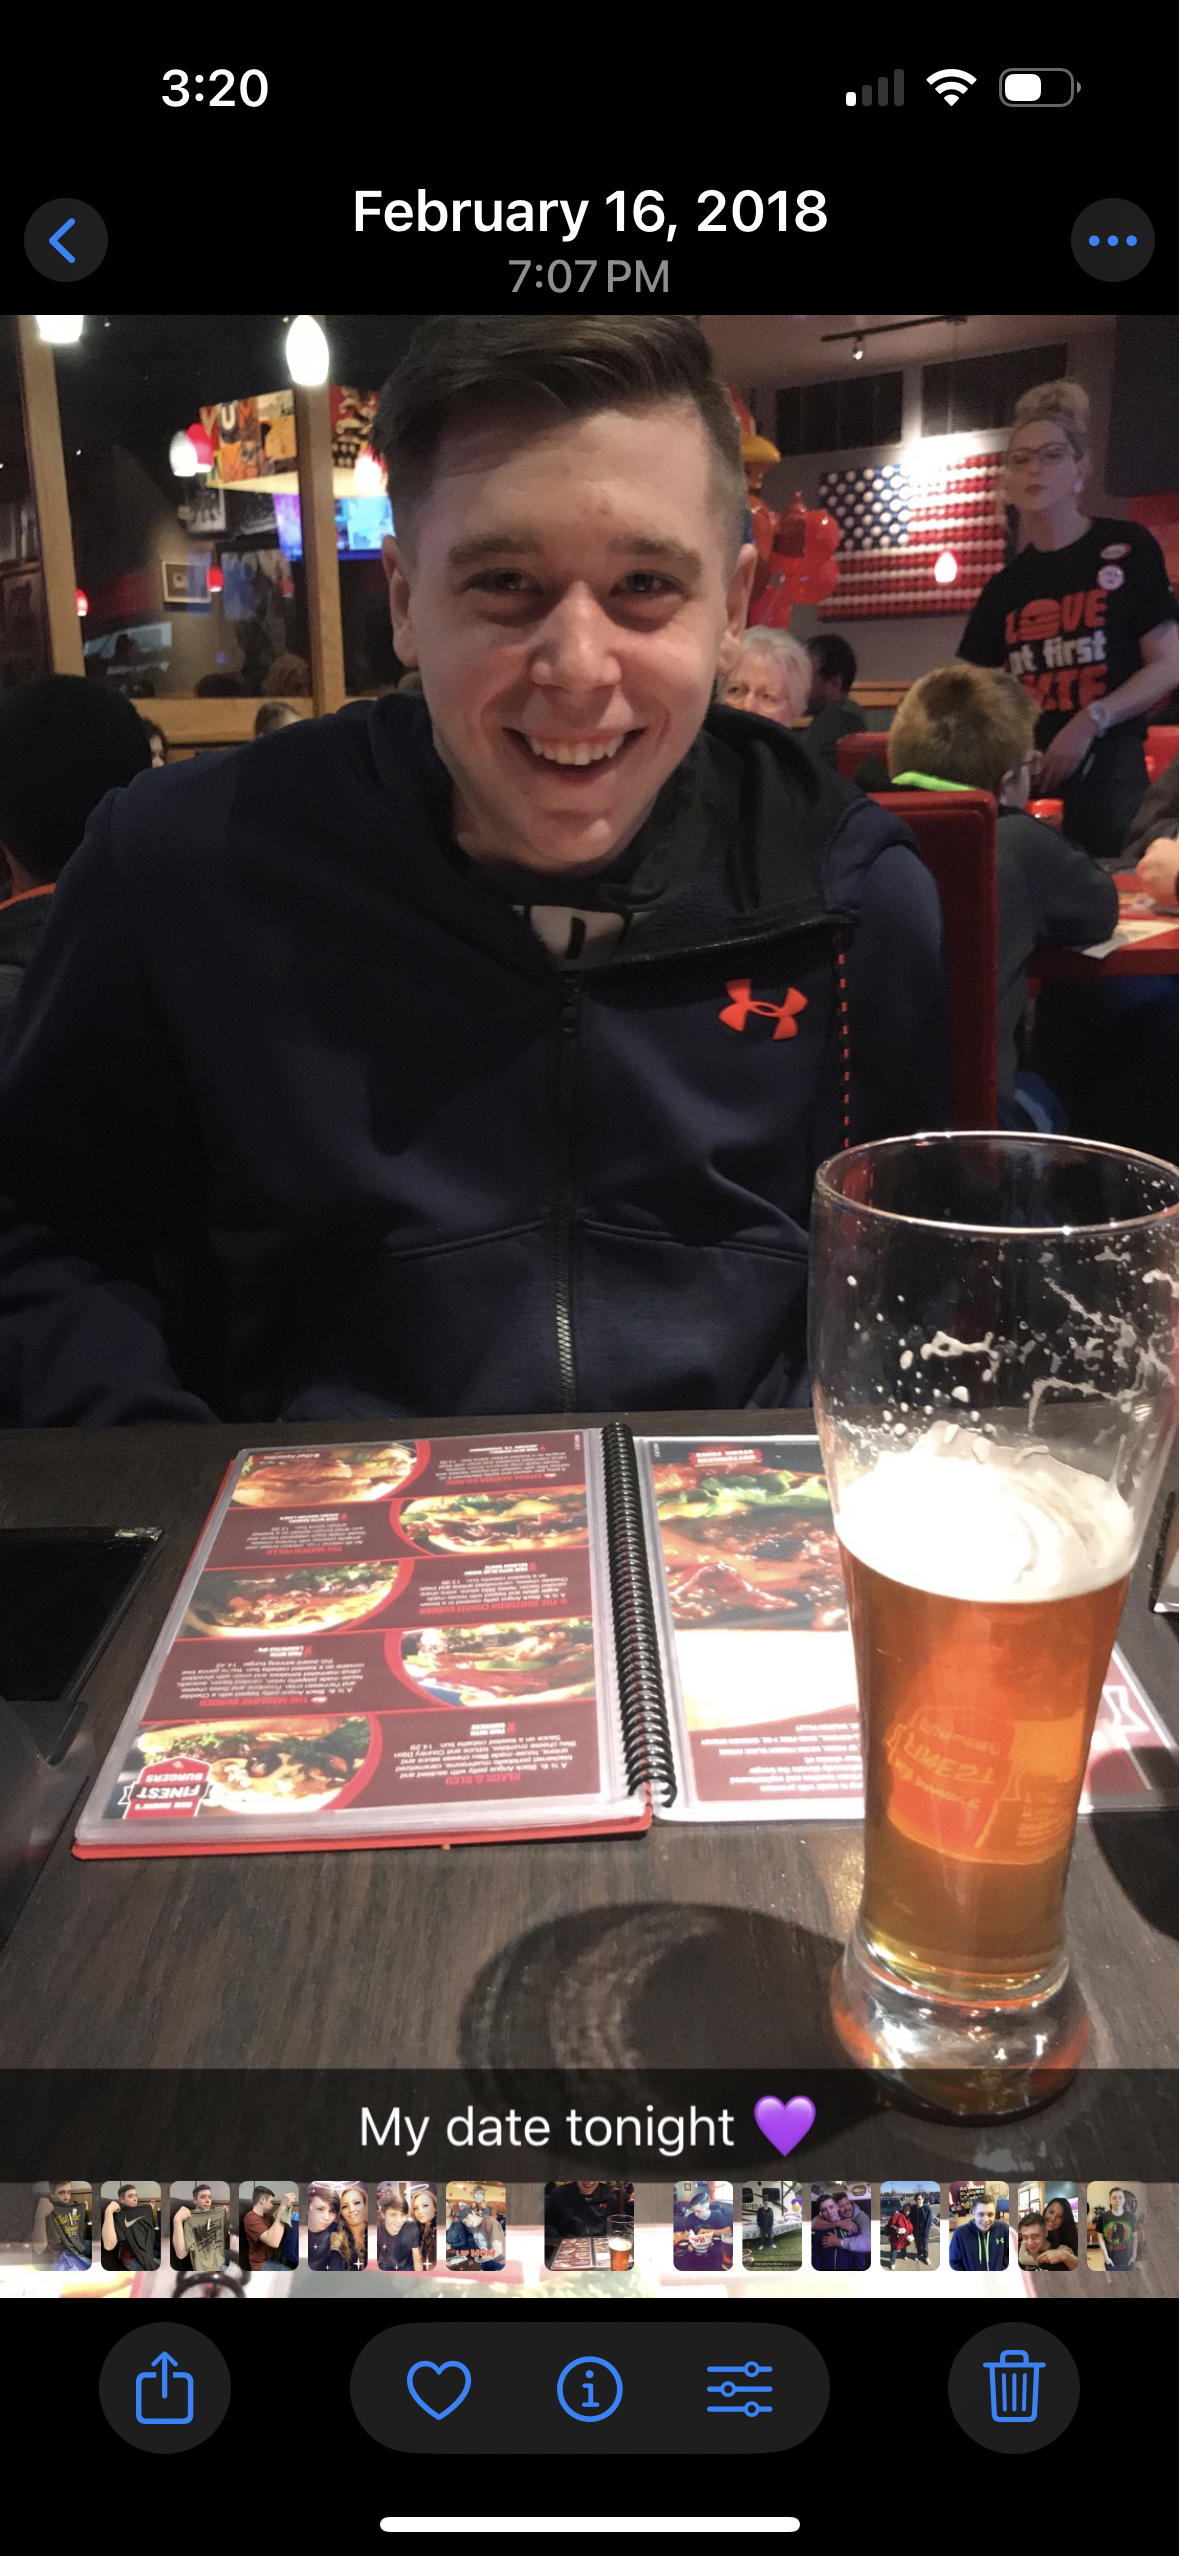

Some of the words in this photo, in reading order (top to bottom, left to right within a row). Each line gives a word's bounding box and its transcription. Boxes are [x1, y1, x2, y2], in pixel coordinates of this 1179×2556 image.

[1006, 588, 1107, 645] LOVE
[1042, 629, 1107, 668] first
[143, 1771, 204, 1783] BURGERS
[444, 1775, 472, 1786] BLEU
[484, 1772, 520, 1782] BLACK
[133, 1783, 201, 1800] FINEST
